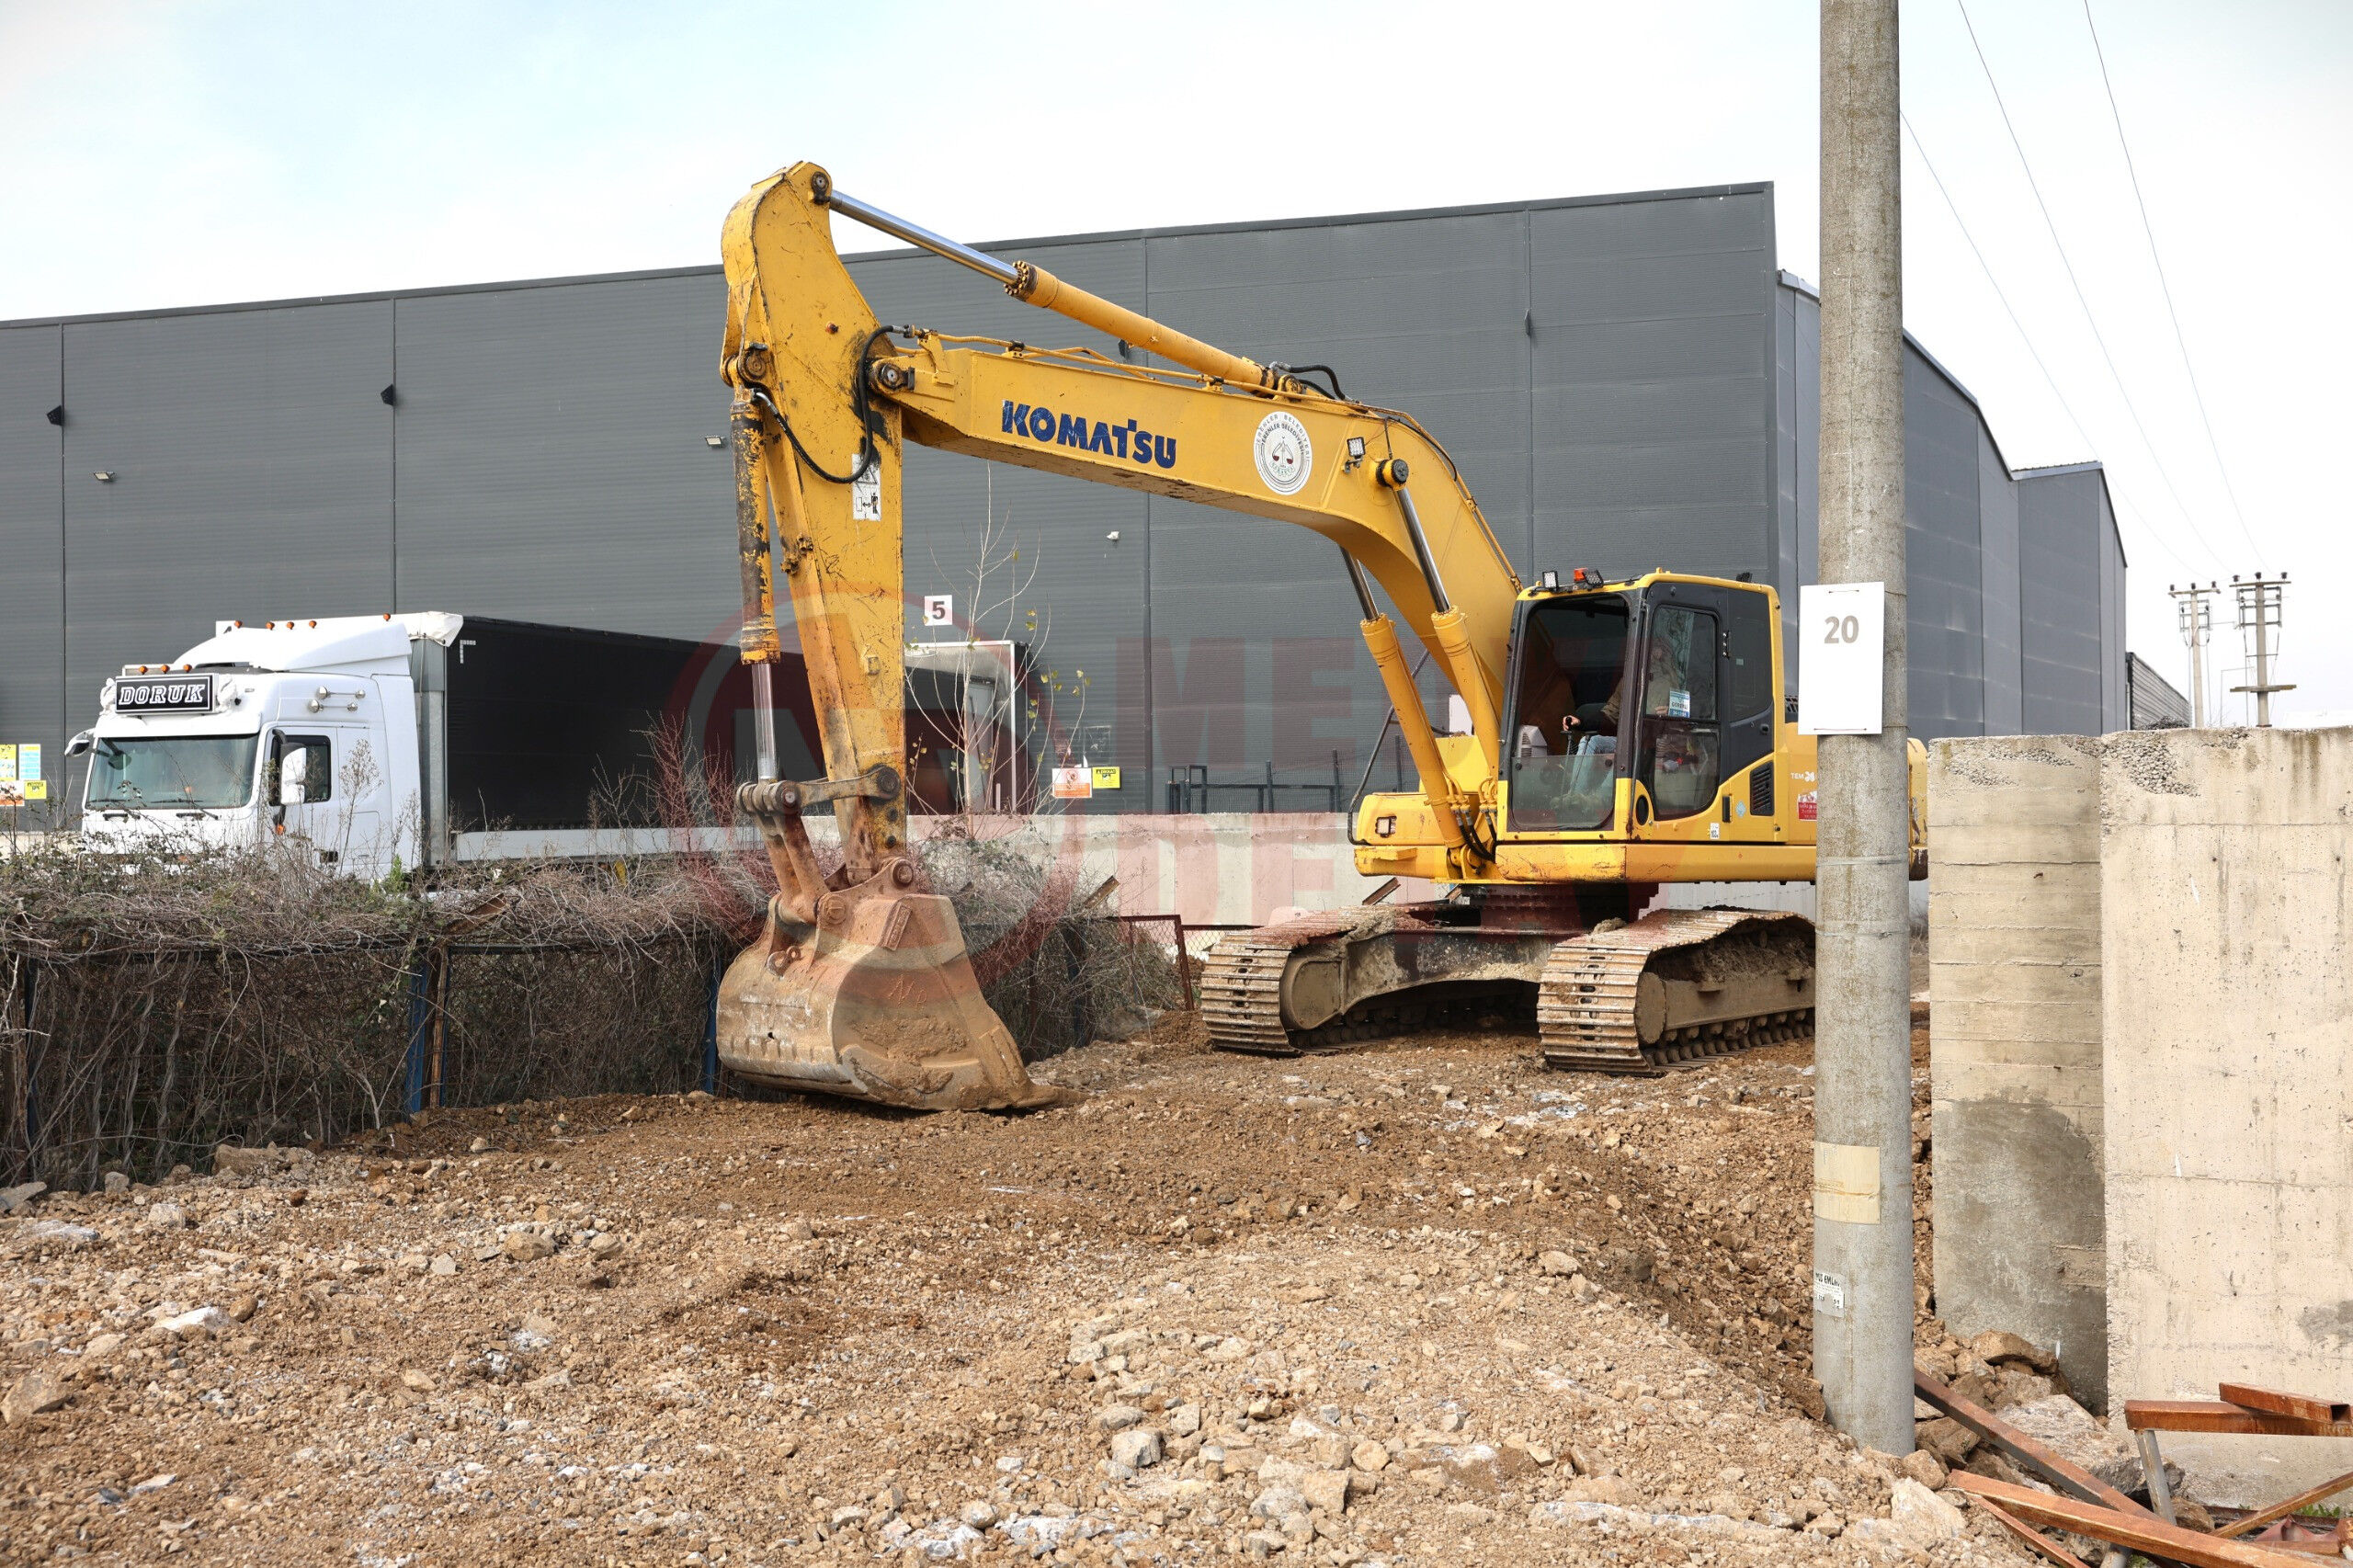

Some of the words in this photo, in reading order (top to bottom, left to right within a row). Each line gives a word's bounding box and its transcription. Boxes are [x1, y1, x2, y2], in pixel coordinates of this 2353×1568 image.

[1002, 400, 1176, 469] KOMATSU
[932, 600, 946, 620] 5
[1824, 615, 1859, 643] 20
[119, 684, 206, 705] DORUK
